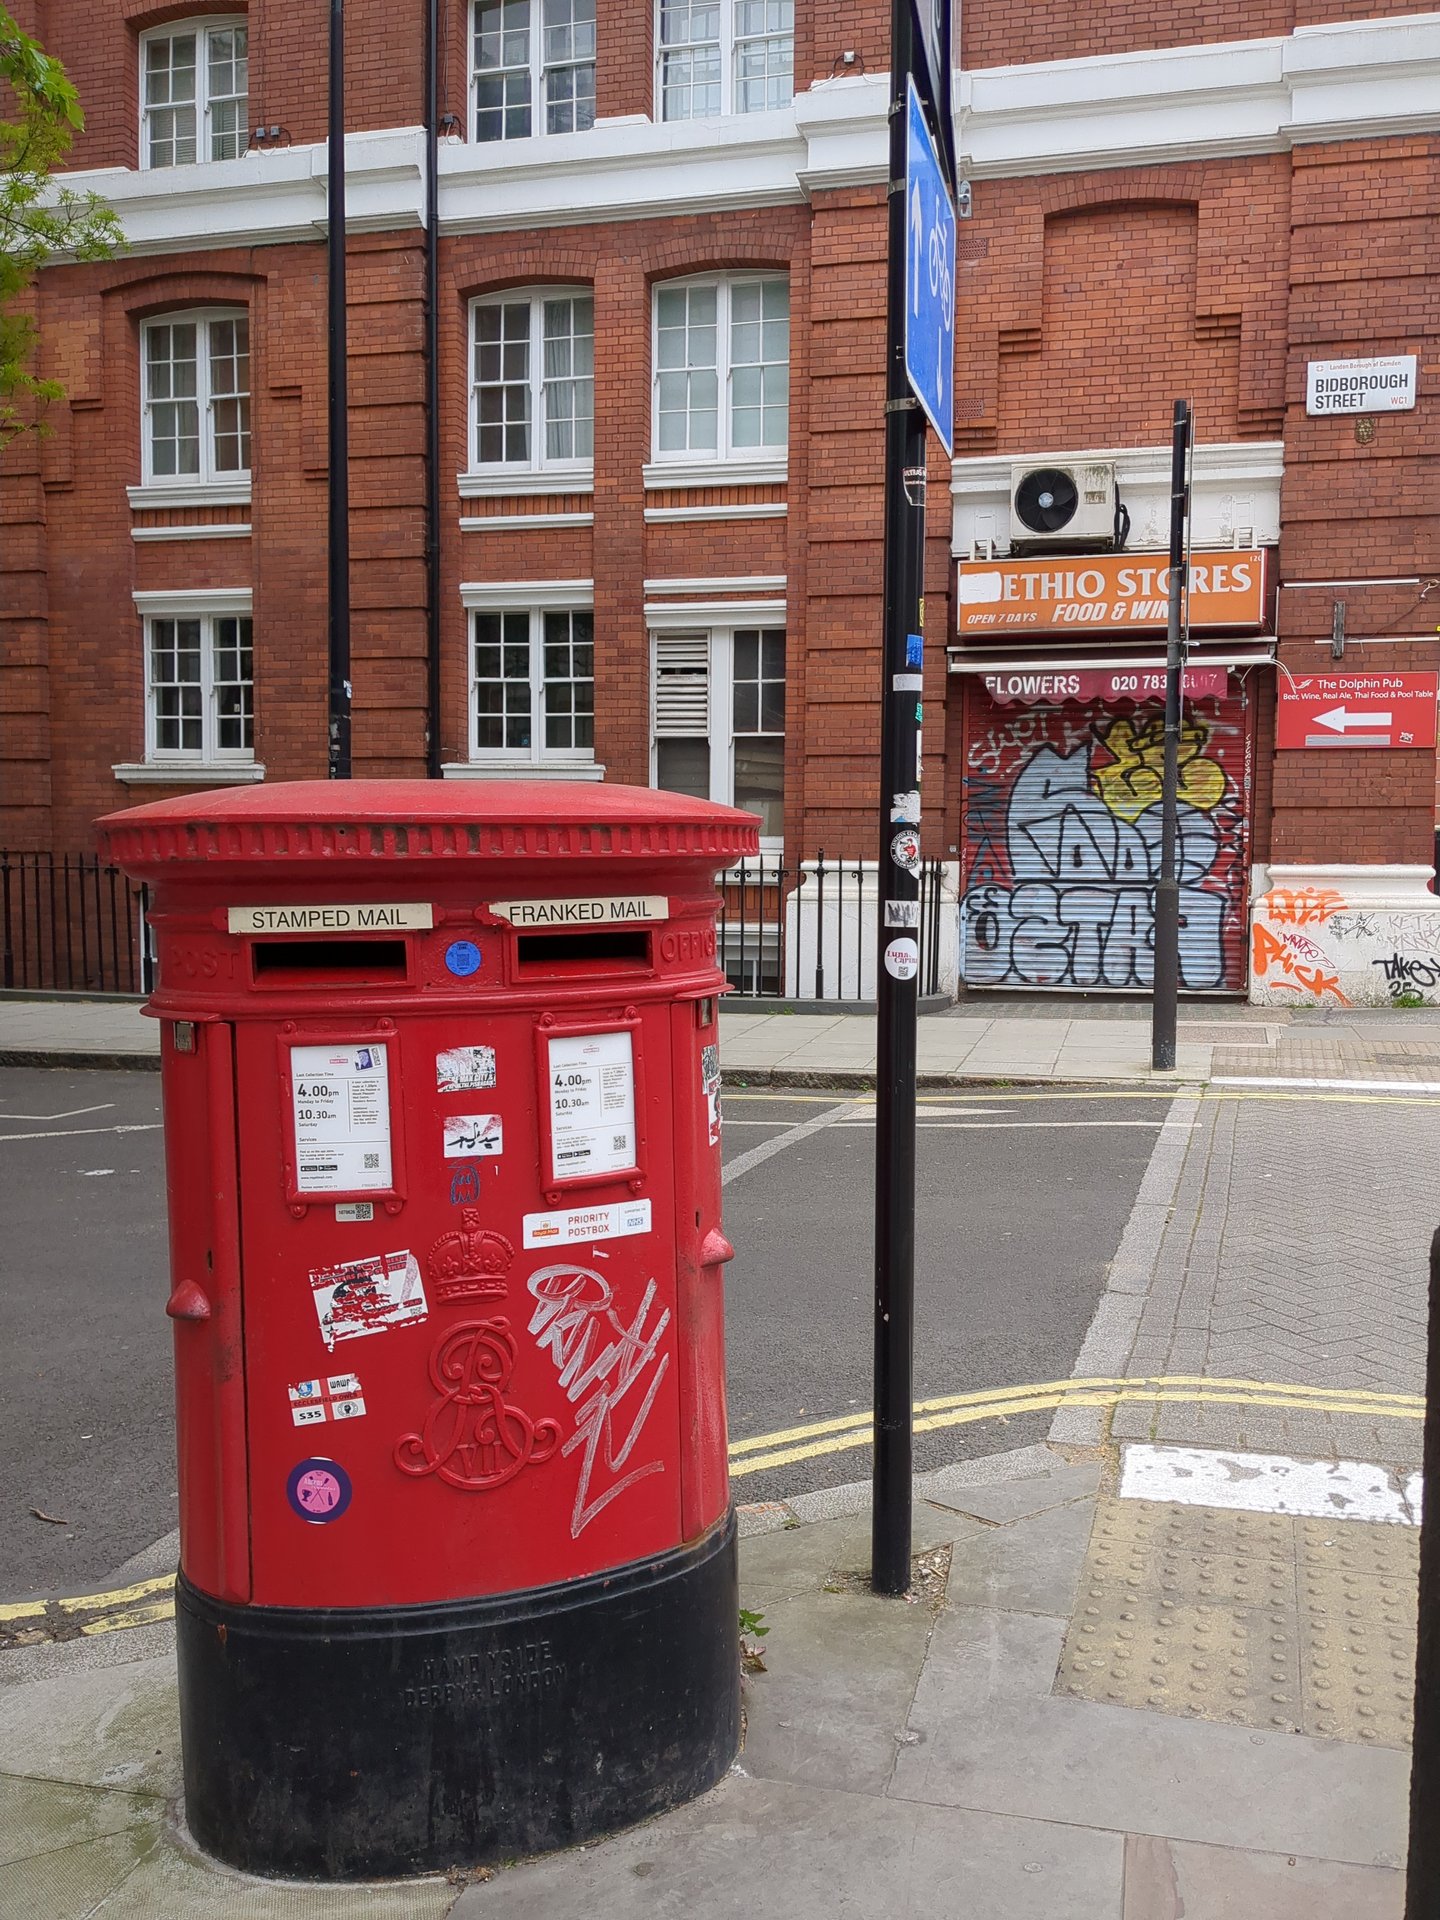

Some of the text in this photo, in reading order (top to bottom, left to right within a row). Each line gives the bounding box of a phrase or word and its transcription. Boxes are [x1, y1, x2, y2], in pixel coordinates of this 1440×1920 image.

[1350, 362, 1372, 370] Borough
[1315, 374, 1408, 393] BIDBOROUGH
[1315, 393, 1408, 409] STREET WC1
[1001, 570, 1106, 601] ETHIO
[967, 600, 1180, 624] OPEN 7 DAYS FOOD & WIN
[986, 674, 1080, 695] FLOWERS
[1112, 676, 1138, 690] 020
[1316, 678, 1403, 691] The Dolphin Pub
[1300, 692, 1322, 700] Wine,
[1339, 692, 1353, 700] Ale,
[1370, 690, 1389, 698] Food
[1397, 690, 1414, 698] Pool
[1414, 690, 1434, 698] Table
[252, 908, 408, 928] STAMPED MAIL
[509, 900, 652, 923] FRANKED MAIL
[554, 1074, 592, 1087] 4.00pm
[298, 1084, 340, 1097] 4.00pm
[555, 1098, 589, 1109] 10.30am
[298, 1109, 336, 1120] 10.30am
[568, 1212, 610, 1225] PRIORITY
[628, 1218, 642, 1226] NHS
[568, 1224, 610, 1237] POSTBOX
[299, 1410, 322, 1420] S35
